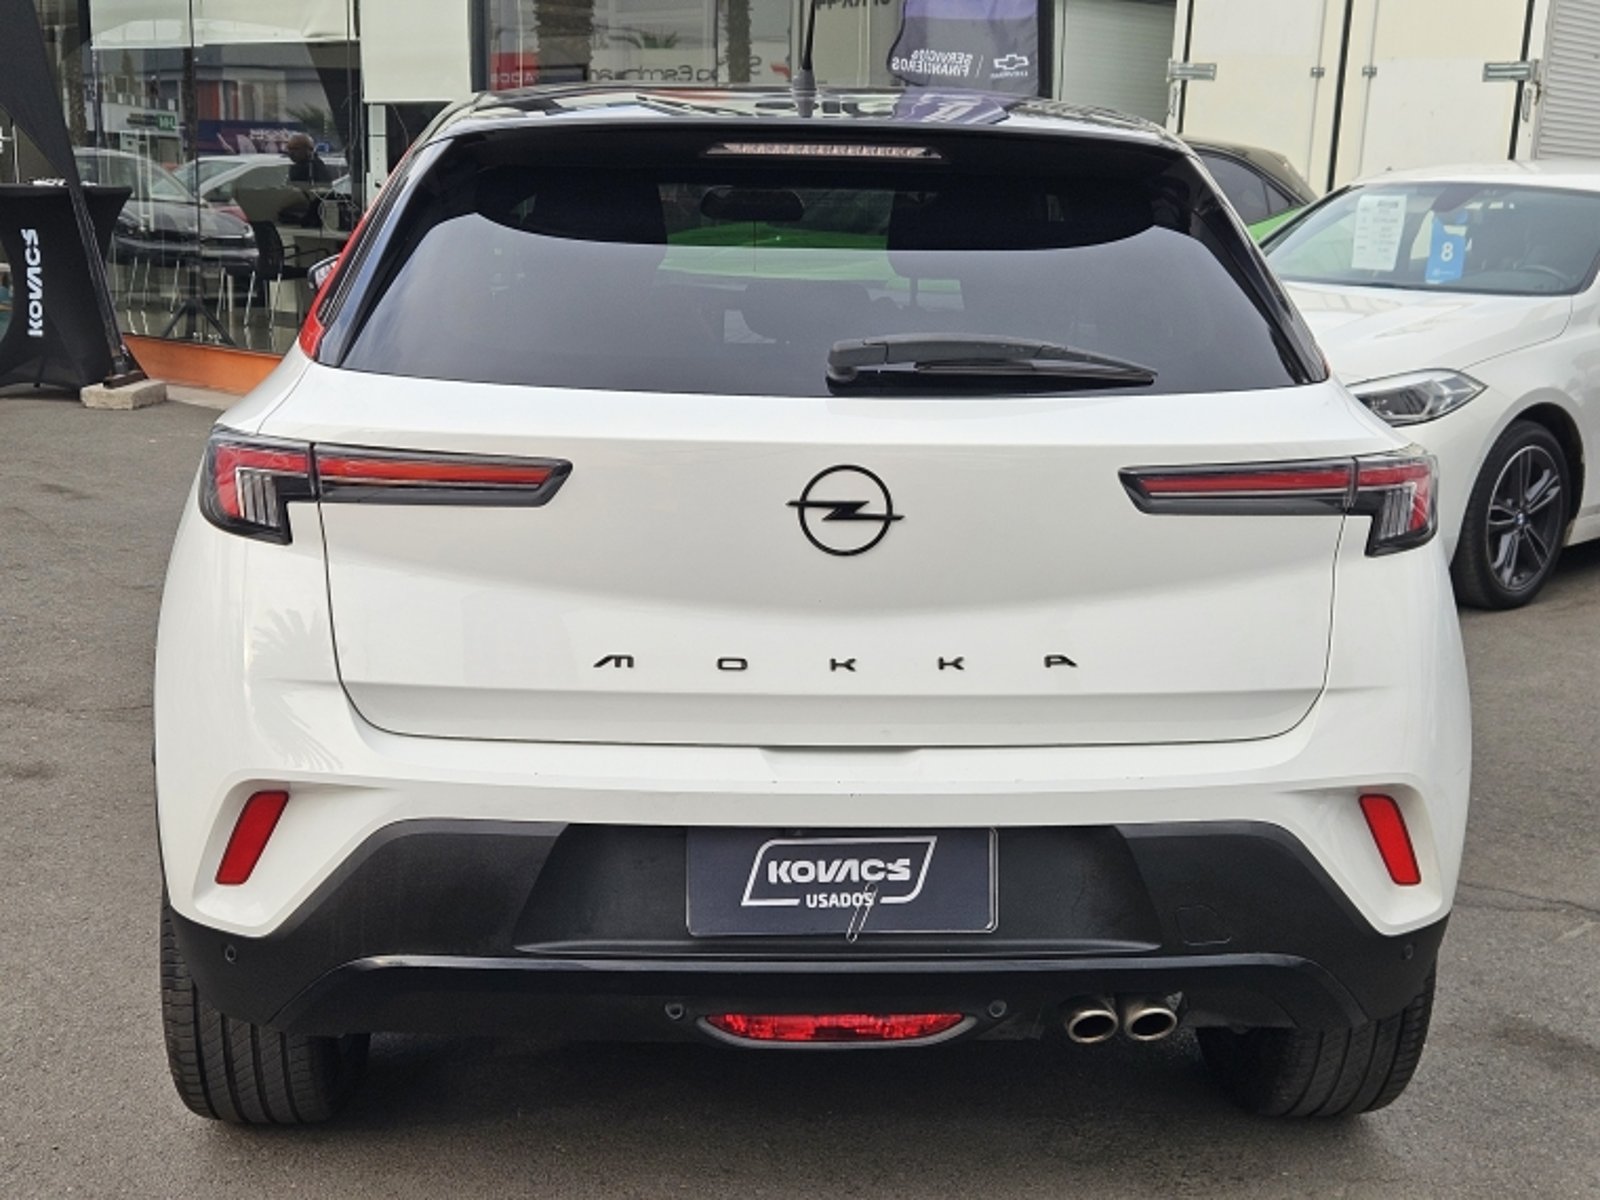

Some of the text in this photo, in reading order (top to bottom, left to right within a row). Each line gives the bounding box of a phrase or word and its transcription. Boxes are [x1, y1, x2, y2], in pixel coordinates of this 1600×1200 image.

[1441, 241, 1454, 261] 8
[20, 229, 43, 337] KOVACS
[593, 654, 1077, 671] MOKKA
[768, 858, 910, 884] KOVACS
[806, 893, 874, 908] USADOS
